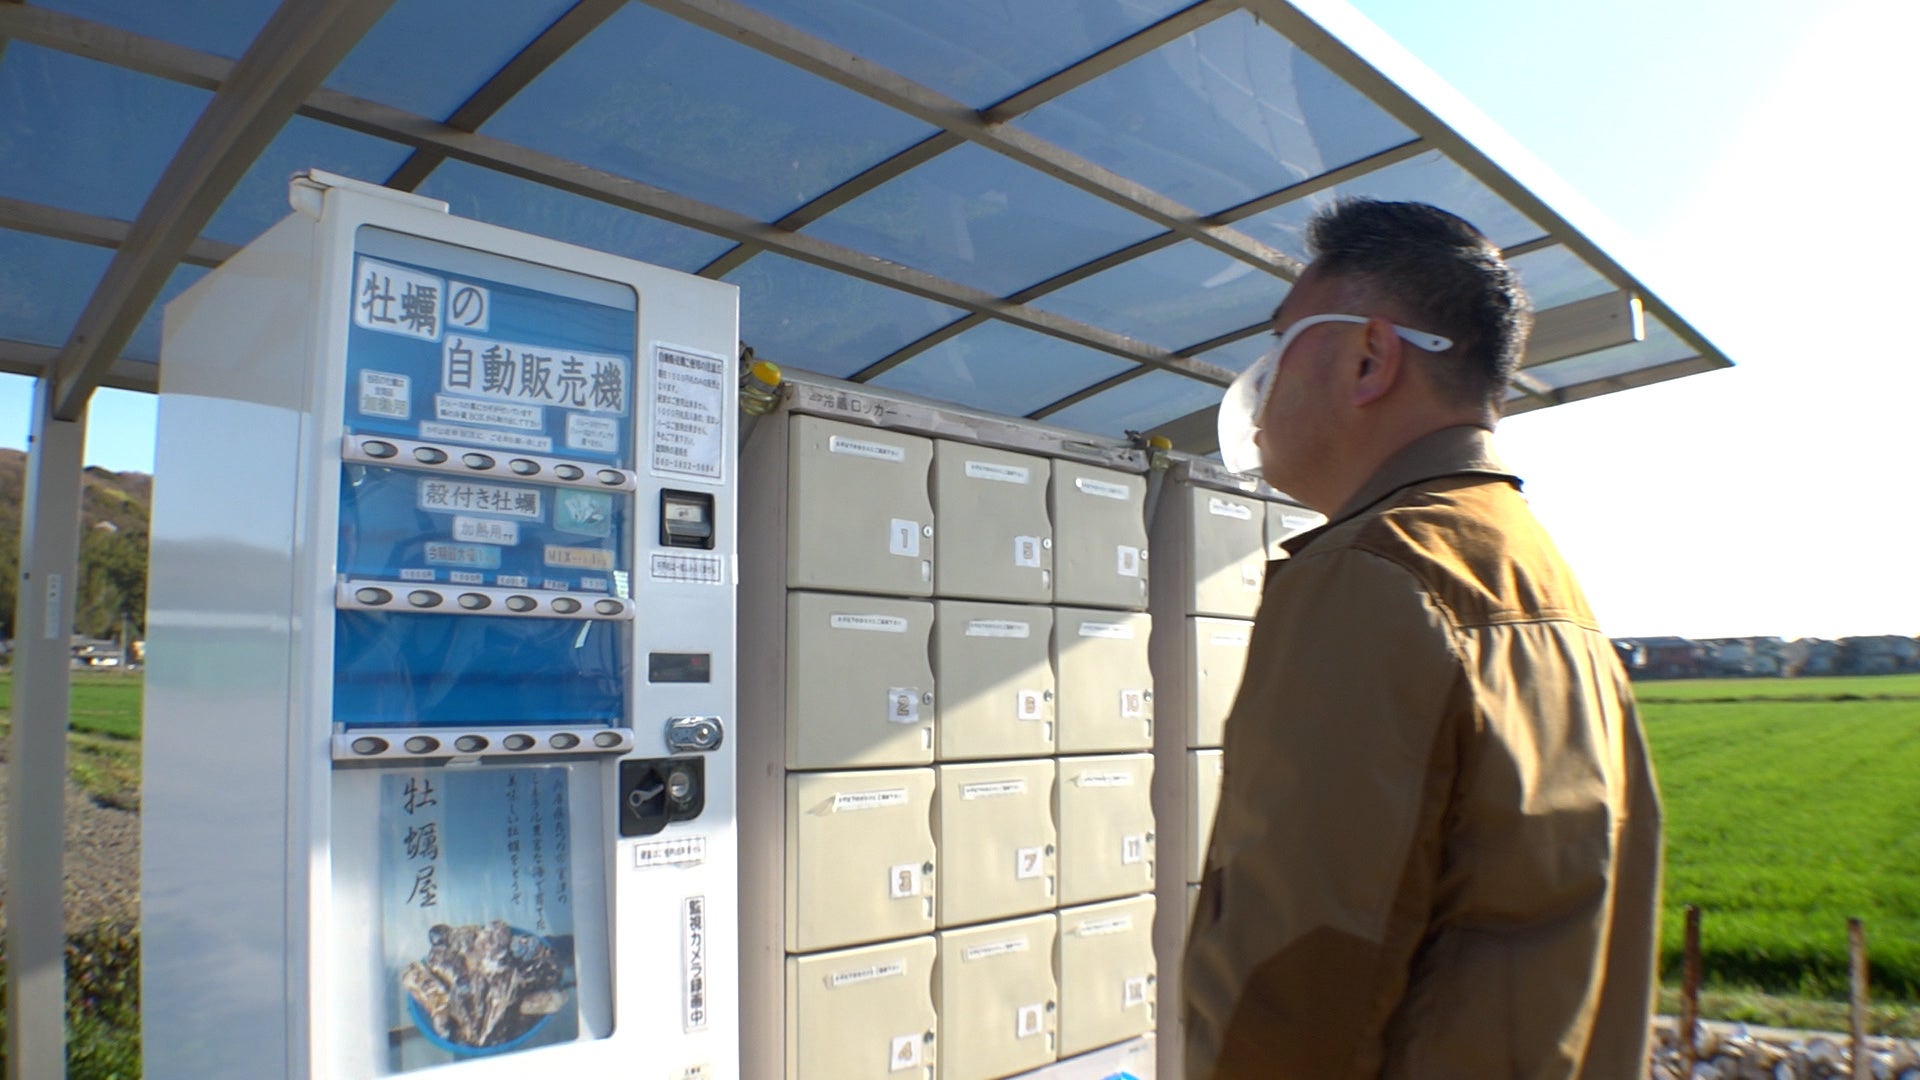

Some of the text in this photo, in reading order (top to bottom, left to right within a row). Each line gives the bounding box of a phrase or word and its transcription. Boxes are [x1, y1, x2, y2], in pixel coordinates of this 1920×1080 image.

[361, 271, 483, 337] 牡蠣の
[448, 338, 623, 412] 自動販売機
[426, 483, 537, 515] 殻付き牡蠣
[901, 528, 909, 549] 1
[896, 694, 910, 717] 2
[403, 777, 439, 908] 牡蠣屋
[1128, 839, 1140, 858] 11
[1025, 853, 1037, 872] 7
[899, 870, 912, 892] 3
[689, 900, 703, 1026] 監視カメラ録画中
[897, 1041, 912, 1061] 4
